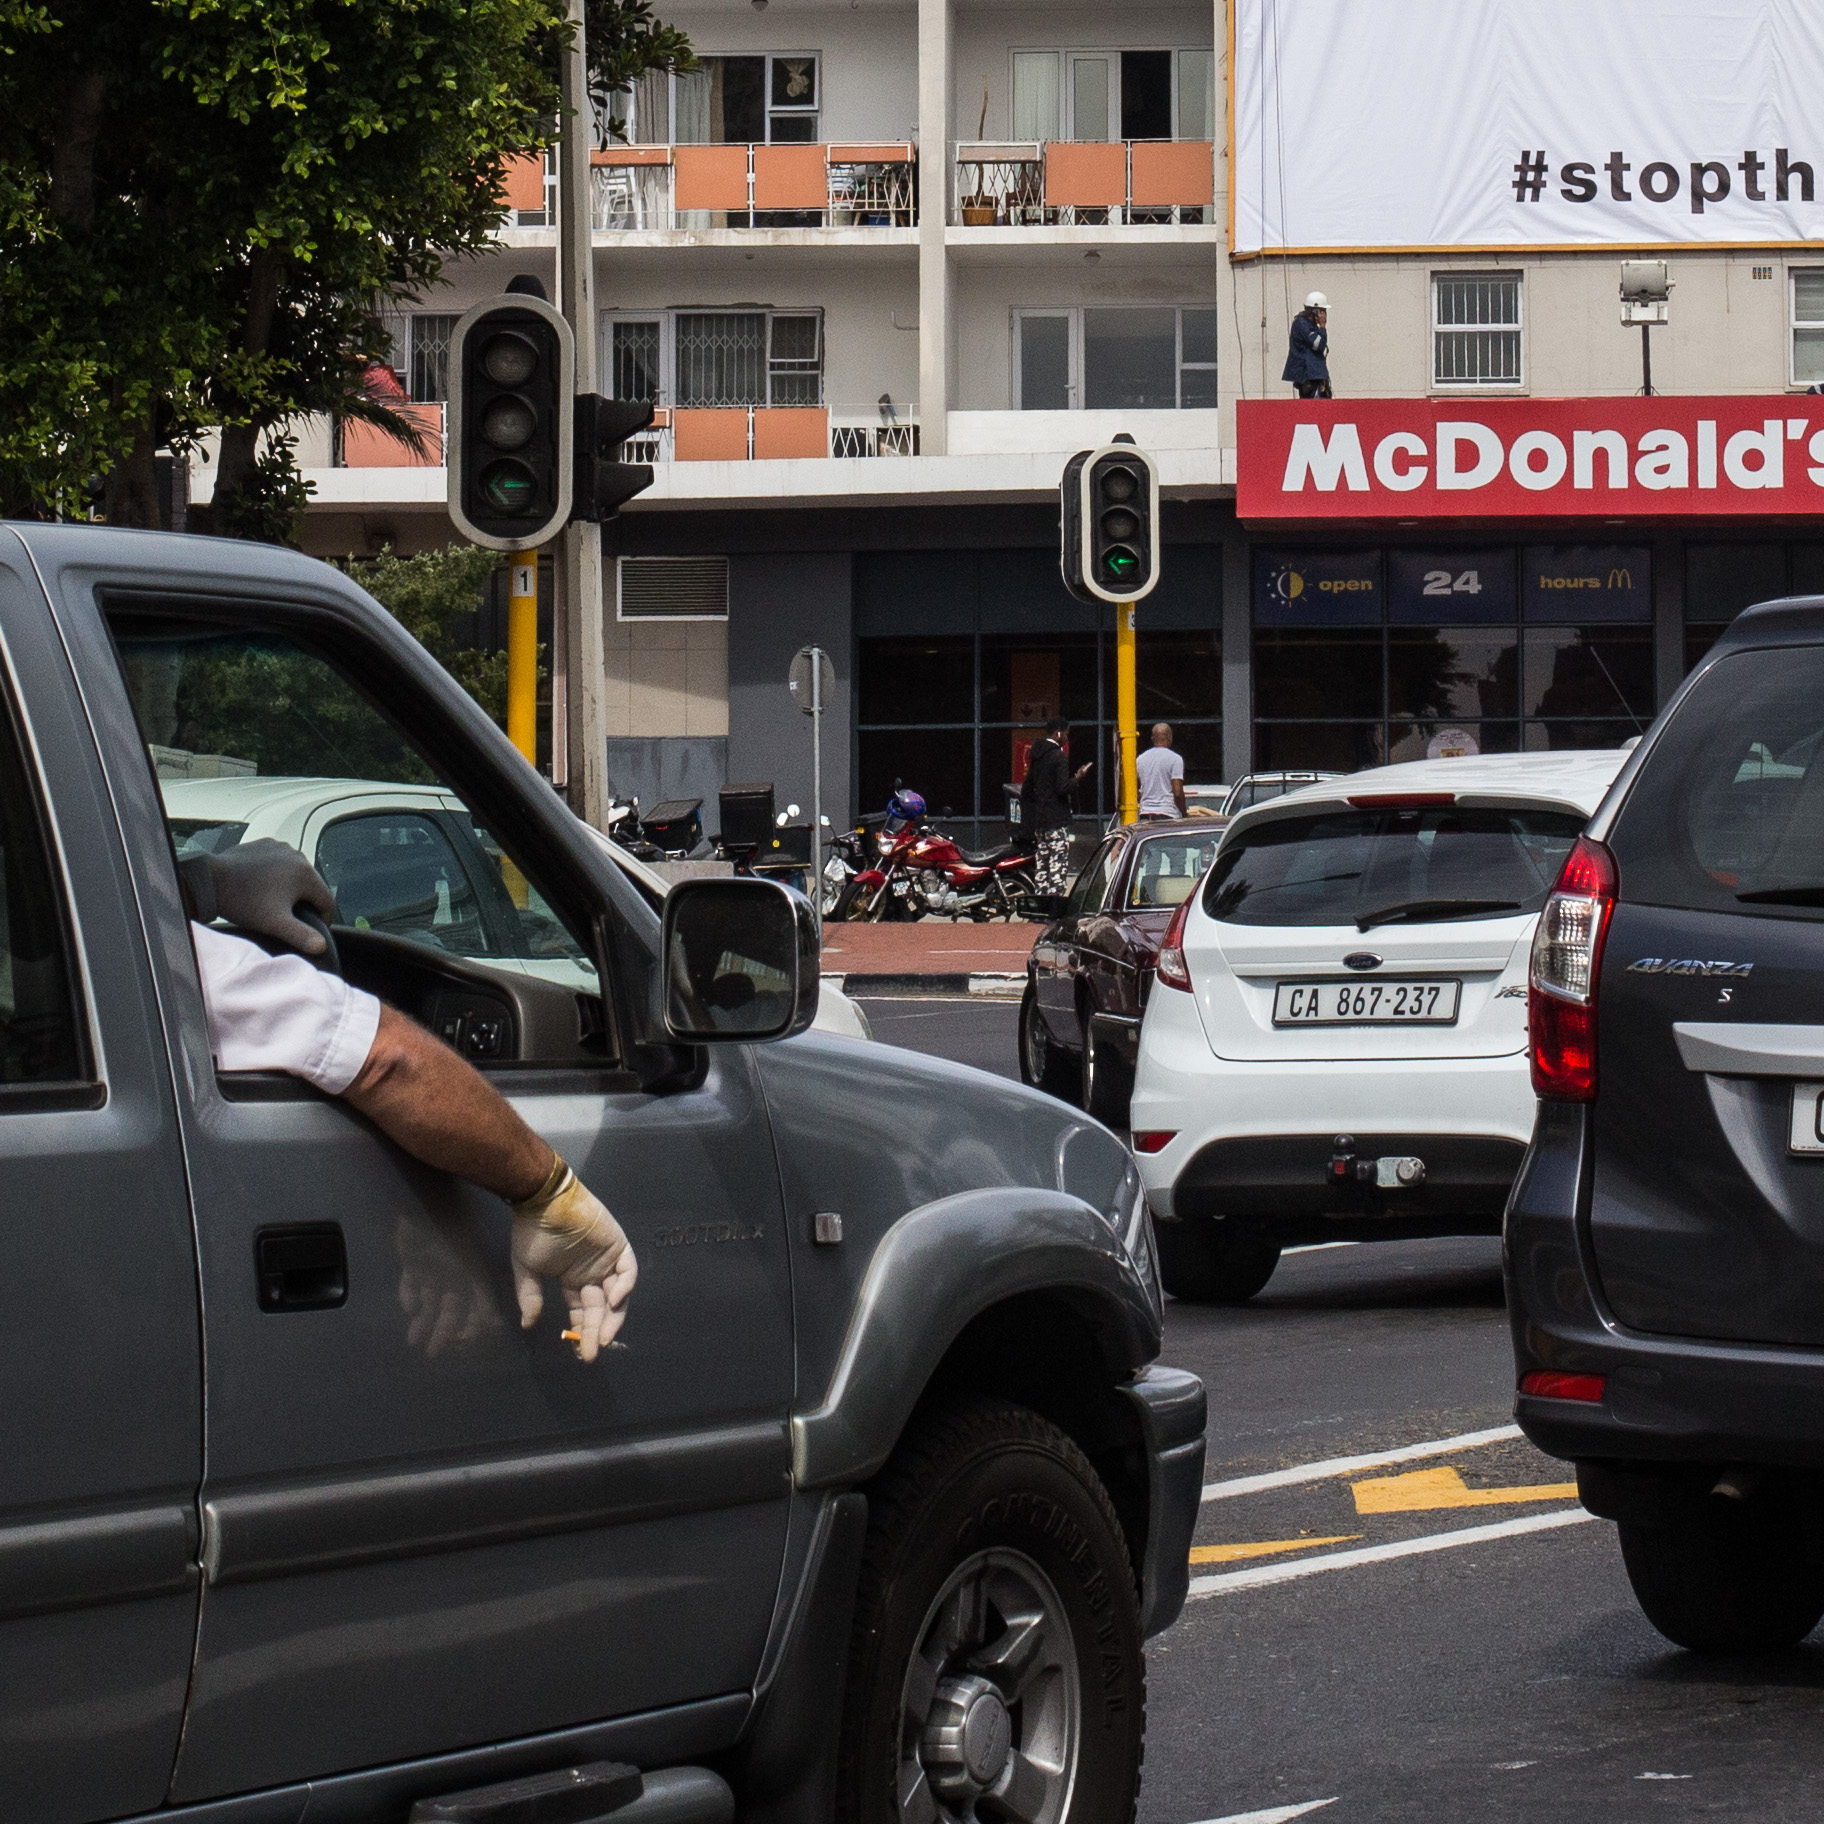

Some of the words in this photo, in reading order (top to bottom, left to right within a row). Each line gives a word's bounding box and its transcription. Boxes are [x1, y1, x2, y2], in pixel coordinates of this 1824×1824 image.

[520, 570, 528, 592] 1
[1319, 577, 1373, 593] open
[1423, 570, 1482, 595] 24
[1540, 575, 1601, 590] hours
[1625, 957, 1755, 977] AVANZA
[1290, 988, 1319, 1018] CA
[1337, 987, 1440, 1017] 867-237
[1718, 988, 1733, 1004] S
